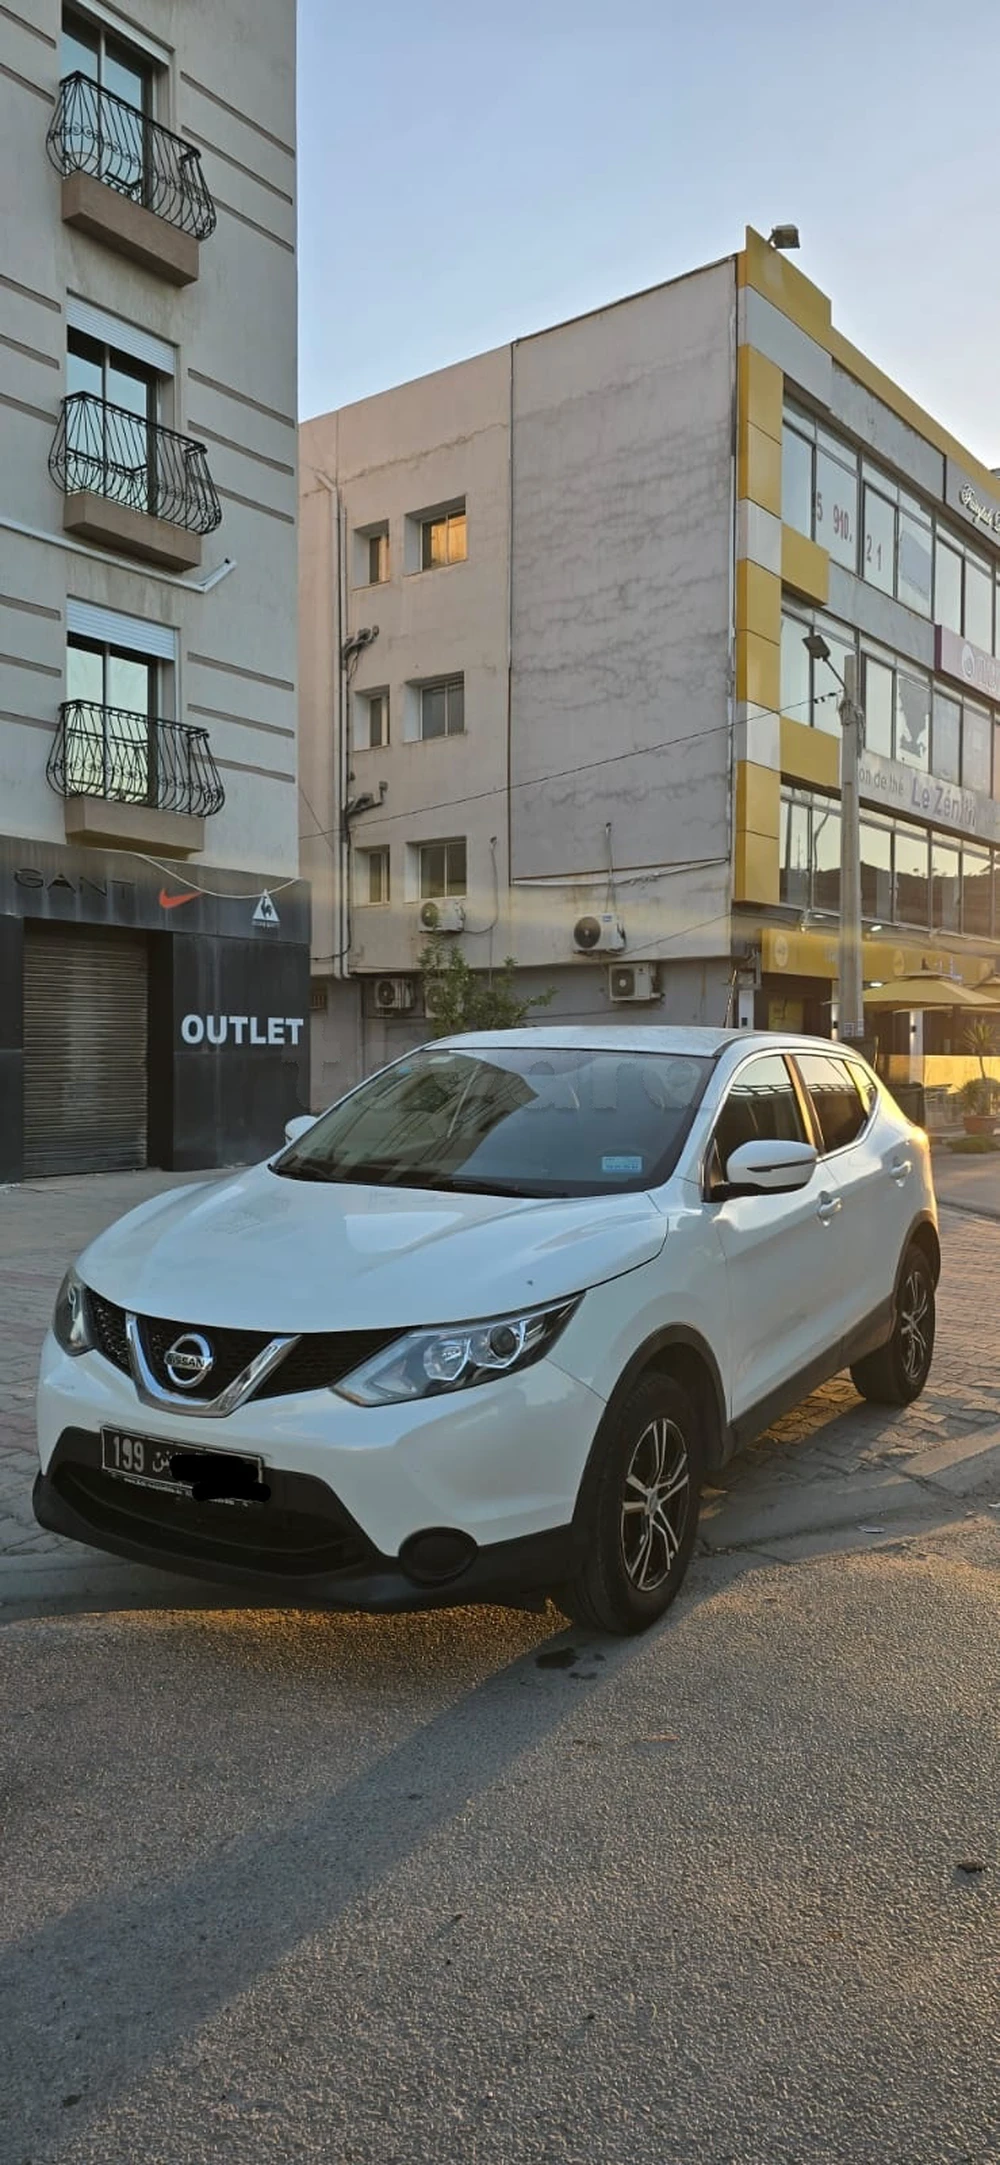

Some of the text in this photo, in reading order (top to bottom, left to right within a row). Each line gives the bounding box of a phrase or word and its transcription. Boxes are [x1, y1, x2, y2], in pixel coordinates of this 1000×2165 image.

[874, 774, 887, 790] de
[911, 778, 931, 809] Le
[934, 785, 977, 828] Zénith
[14, 868, 135, 900] GANT
[182, 1014, 304, 1045] OUTLET
[166, 1352, 206, 1368] NISSAN
[113, 1436, 146, 1473] 199
